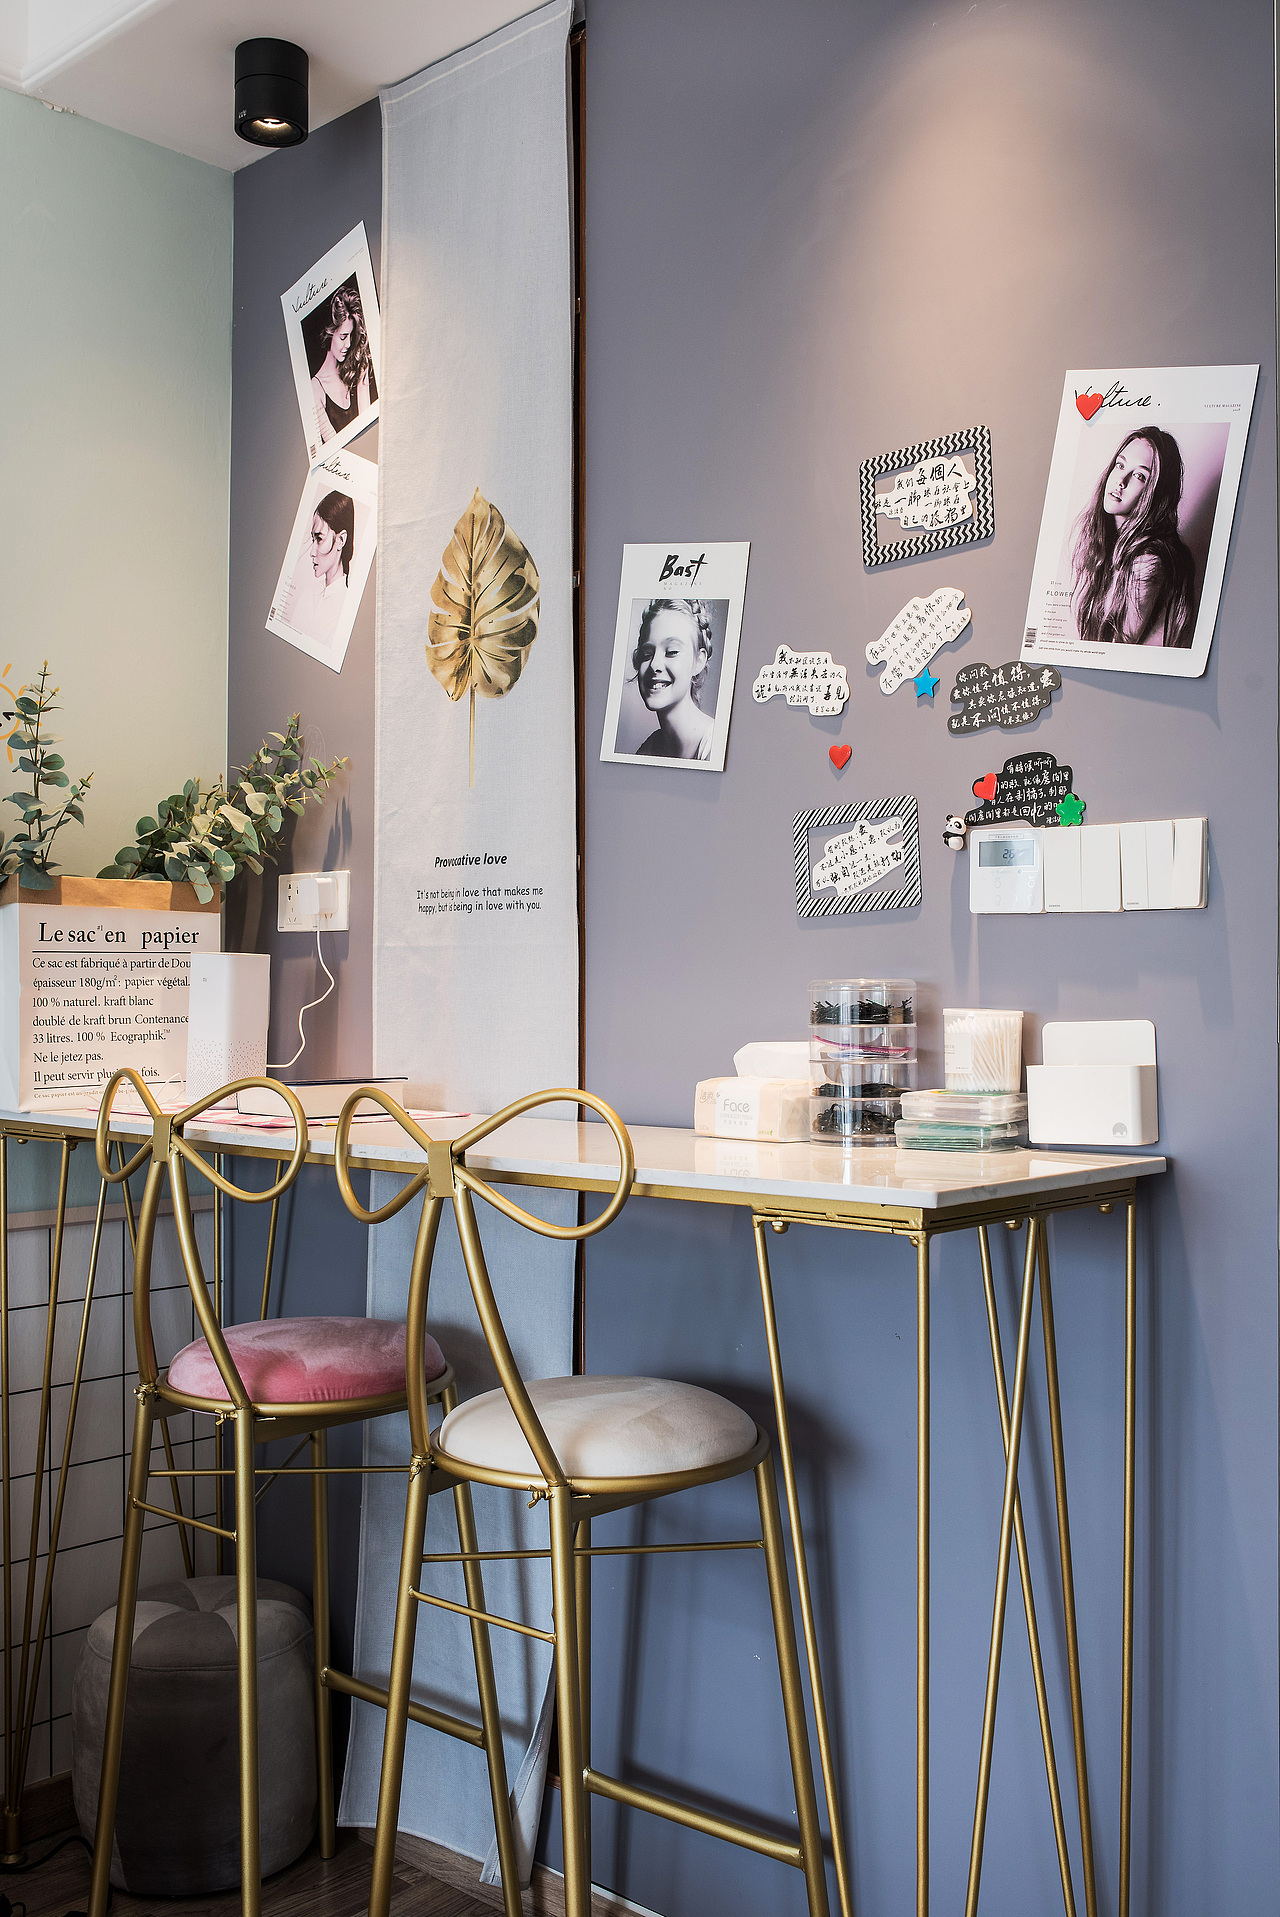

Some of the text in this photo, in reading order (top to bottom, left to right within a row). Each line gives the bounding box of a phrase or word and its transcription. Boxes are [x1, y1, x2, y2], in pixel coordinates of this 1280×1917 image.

[659, 553, 708, 588] Bast
[483, 853, 508, 865] love
[1003, 849, 1015, 858] 26
[417, 886, 543, 900] It's not being in love that makes me
[418, 903, 437, 915] happy,
[438, 902, 448, 912] but
[454, 902, 472, 914] being
[475, 901, 483, 911] in
[485, 900, 503, 910] love
[506, 900, 524, 910] with
[526, 902, 541, 912] you.
[38, 922, 63, 942] Le
[68, 930, 96, 943] sac
[104, 930, 126, 943] en
[142, 927, 199, 949] papier
[32, 958, 46, 968] Ce
[65, 960, 78, 968] est
[80, 958, 120, 972] fabriqué
[122, 958, 128, 968] à
[130, 958, 156, 971] partir
[158, 958, 169, 968] de
[33, 977, 76, 991] épaisseur
[125, 976, 154, 989] papier
[157, 976, 190, 989] végétal.
[32, 996, 154, 1007] 100 % naturel. kraft blanc
[32, 1014, 189, 1026] doublé de kraft brun Contenance
[33, 1033, 44, 1043] 33
[46, 1033, 73, 1043] litres.
[77, 1032, 93, 1041] 100
[96, 1032, 105, 1041] %
[34, 1052, 104, 1065] Ne le jetez pas.
[34, 1071, 41, 1082] Il
[43, 1072, 65, 1084] peut
[67, 1070, 94, 1080] servir
[141, 1067, 160, 1077] fois.
[723, 1099, 750, 1113] Face
